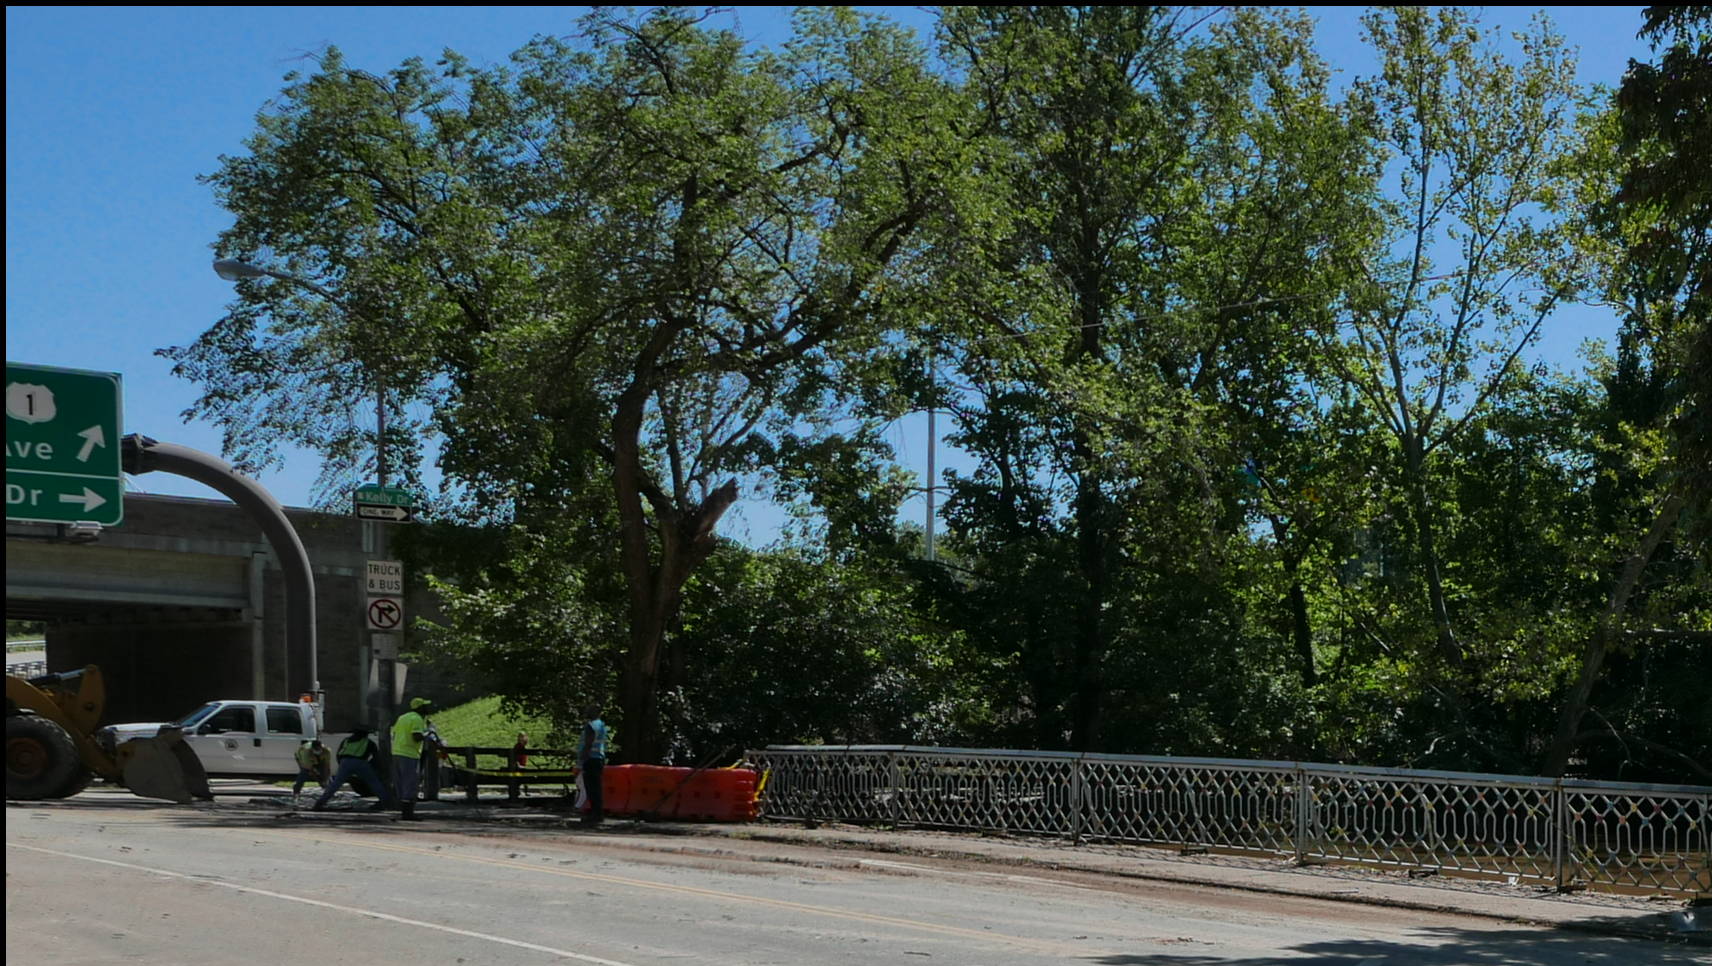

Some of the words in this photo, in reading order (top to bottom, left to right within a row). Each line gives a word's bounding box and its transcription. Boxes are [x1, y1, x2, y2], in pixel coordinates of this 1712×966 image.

[26, 394, 33, 415] 1
[6, 484, 43, 506] Dr
[368, 563, 400, 575] TRUCK
[368, 579, 374, 588] &
[379, 579, 400, 590] BUS
